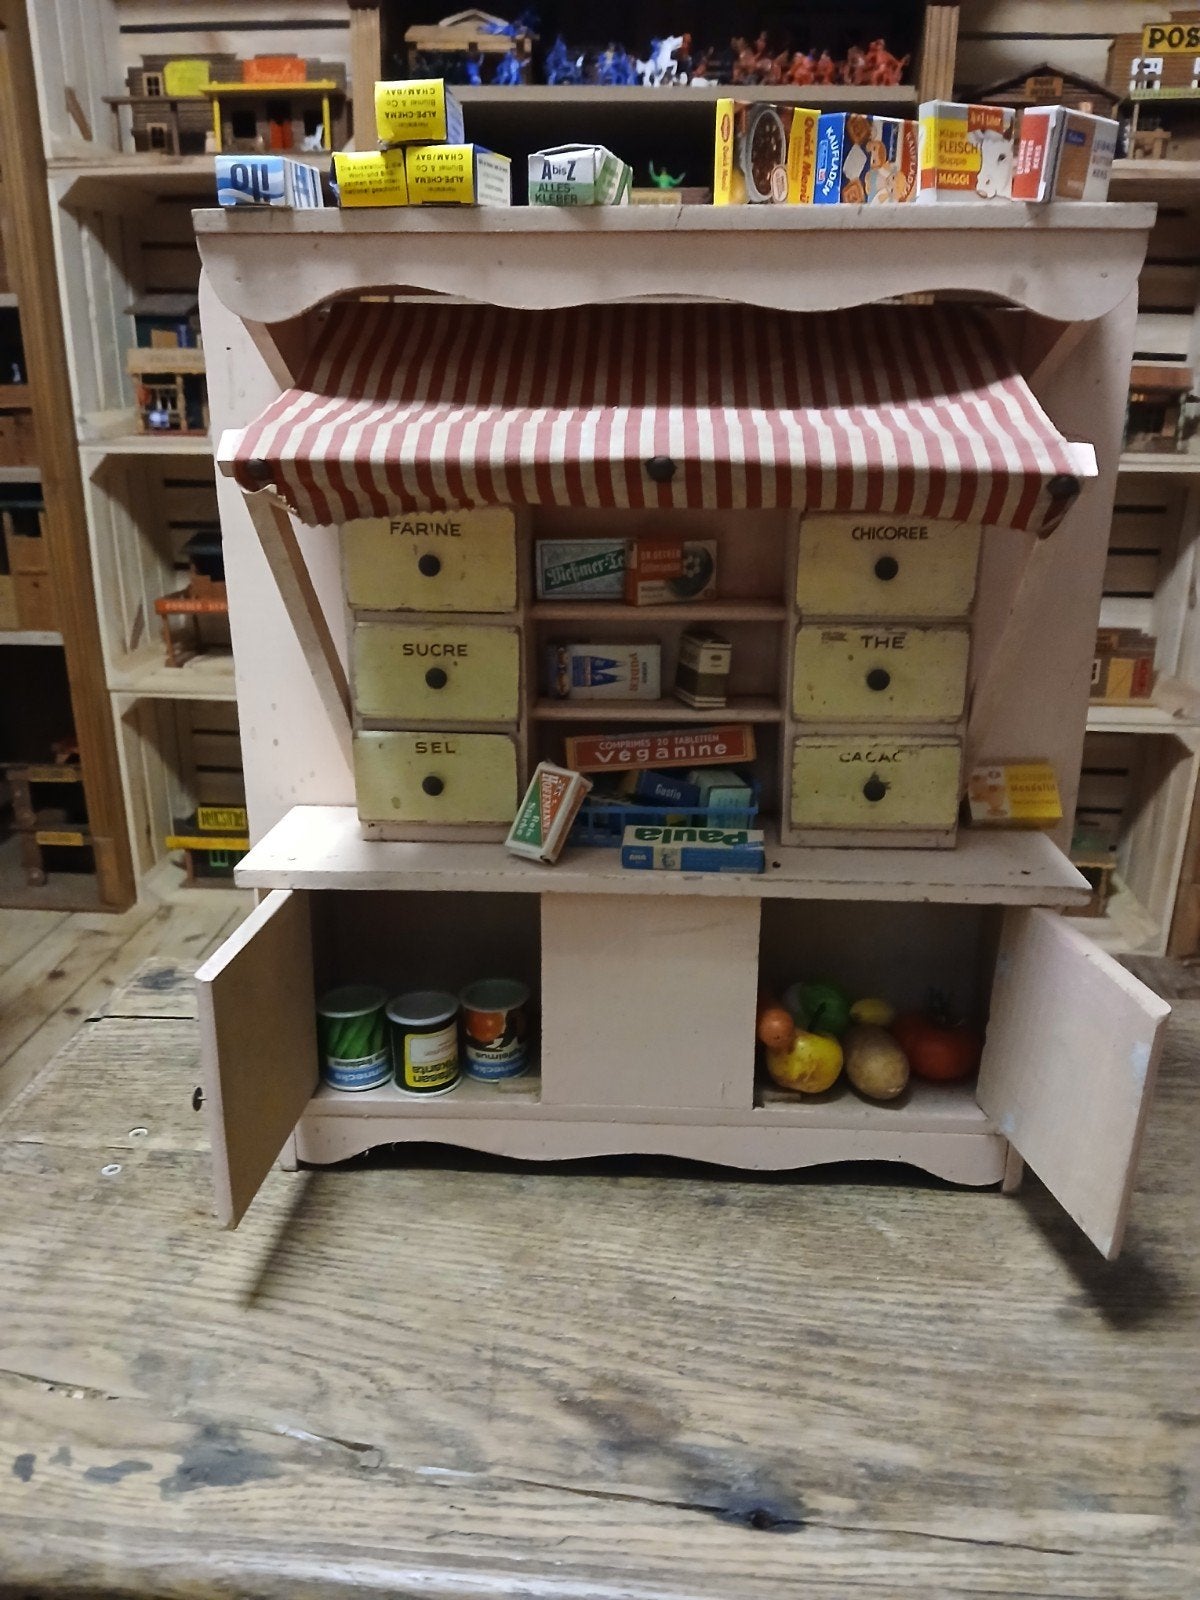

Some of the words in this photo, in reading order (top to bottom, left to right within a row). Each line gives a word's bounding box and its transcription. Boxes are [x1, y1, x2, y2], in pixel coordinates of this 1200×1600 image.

[939, 140, 979, 154] FLEISCH
[821, 125, 841, 197] KAUFLADEN
[938, 172, 971, 186] MAGGI
[538, 182, 575, 193] ALLES-
[534, 193, 578, 205] KLEBER
[390, 522, 462, 537] FARINE
[851, 526, 930, 541] CHICOREE
[546, 552, 624, 585] Meßmer-Te
[861, 635, 905, 649] THE
[402, 643, 469, 657] SUCRE
[415, 741, 456, 754] SEL
[598, 738, 651, 751] COMPRIMES
[656, 737, 669, 747] 20
[673, 733, 720, 745] TABLETTEN
[654, 783, 683, 801] Gustin
[634, 827, 749, 846] Paula
